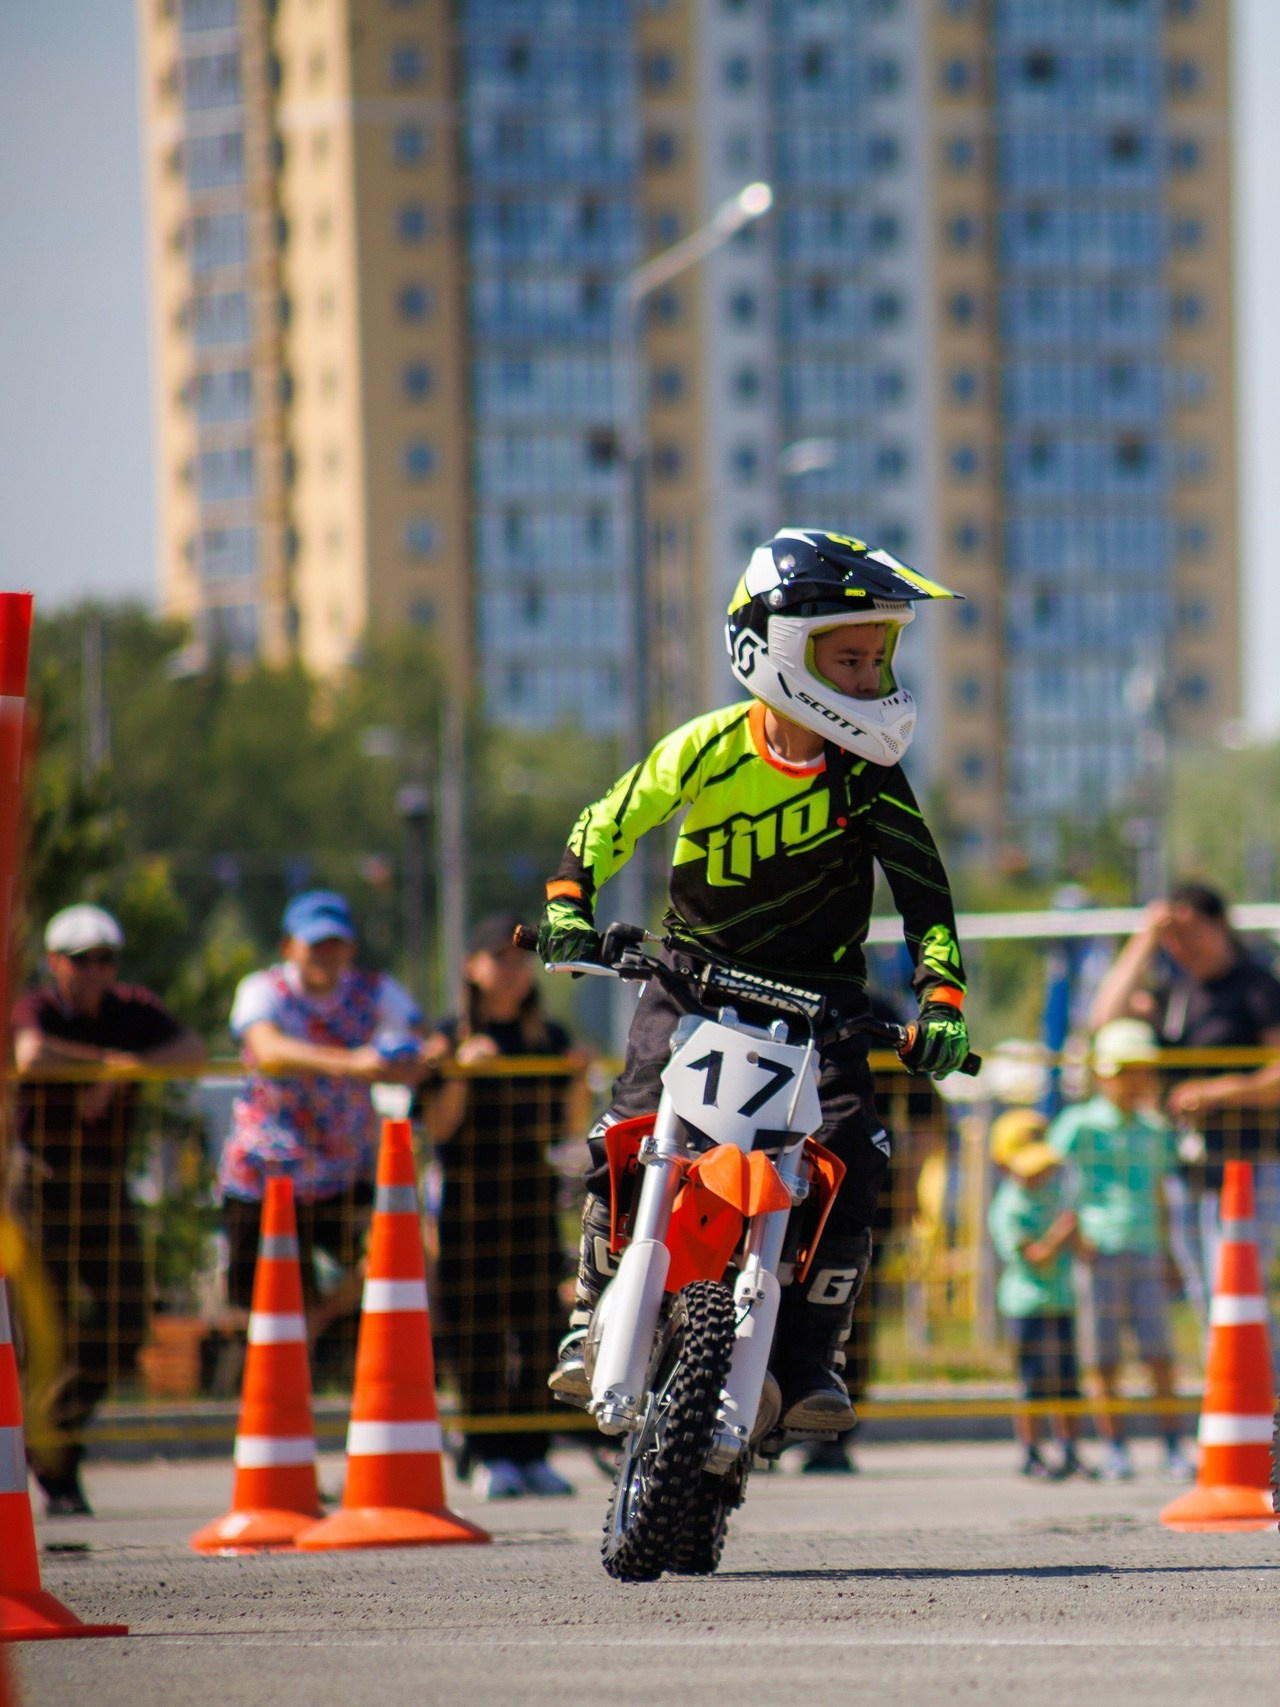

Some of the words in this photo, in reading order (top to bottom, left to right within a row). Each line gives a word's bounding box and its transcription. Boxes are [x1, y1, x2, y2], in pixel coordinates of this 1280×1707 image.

[795, 691, 868, 737] SCOTT
[716, 964, 822, 1002] RENTHAL
[686, 1049, 796, 1118] 17
